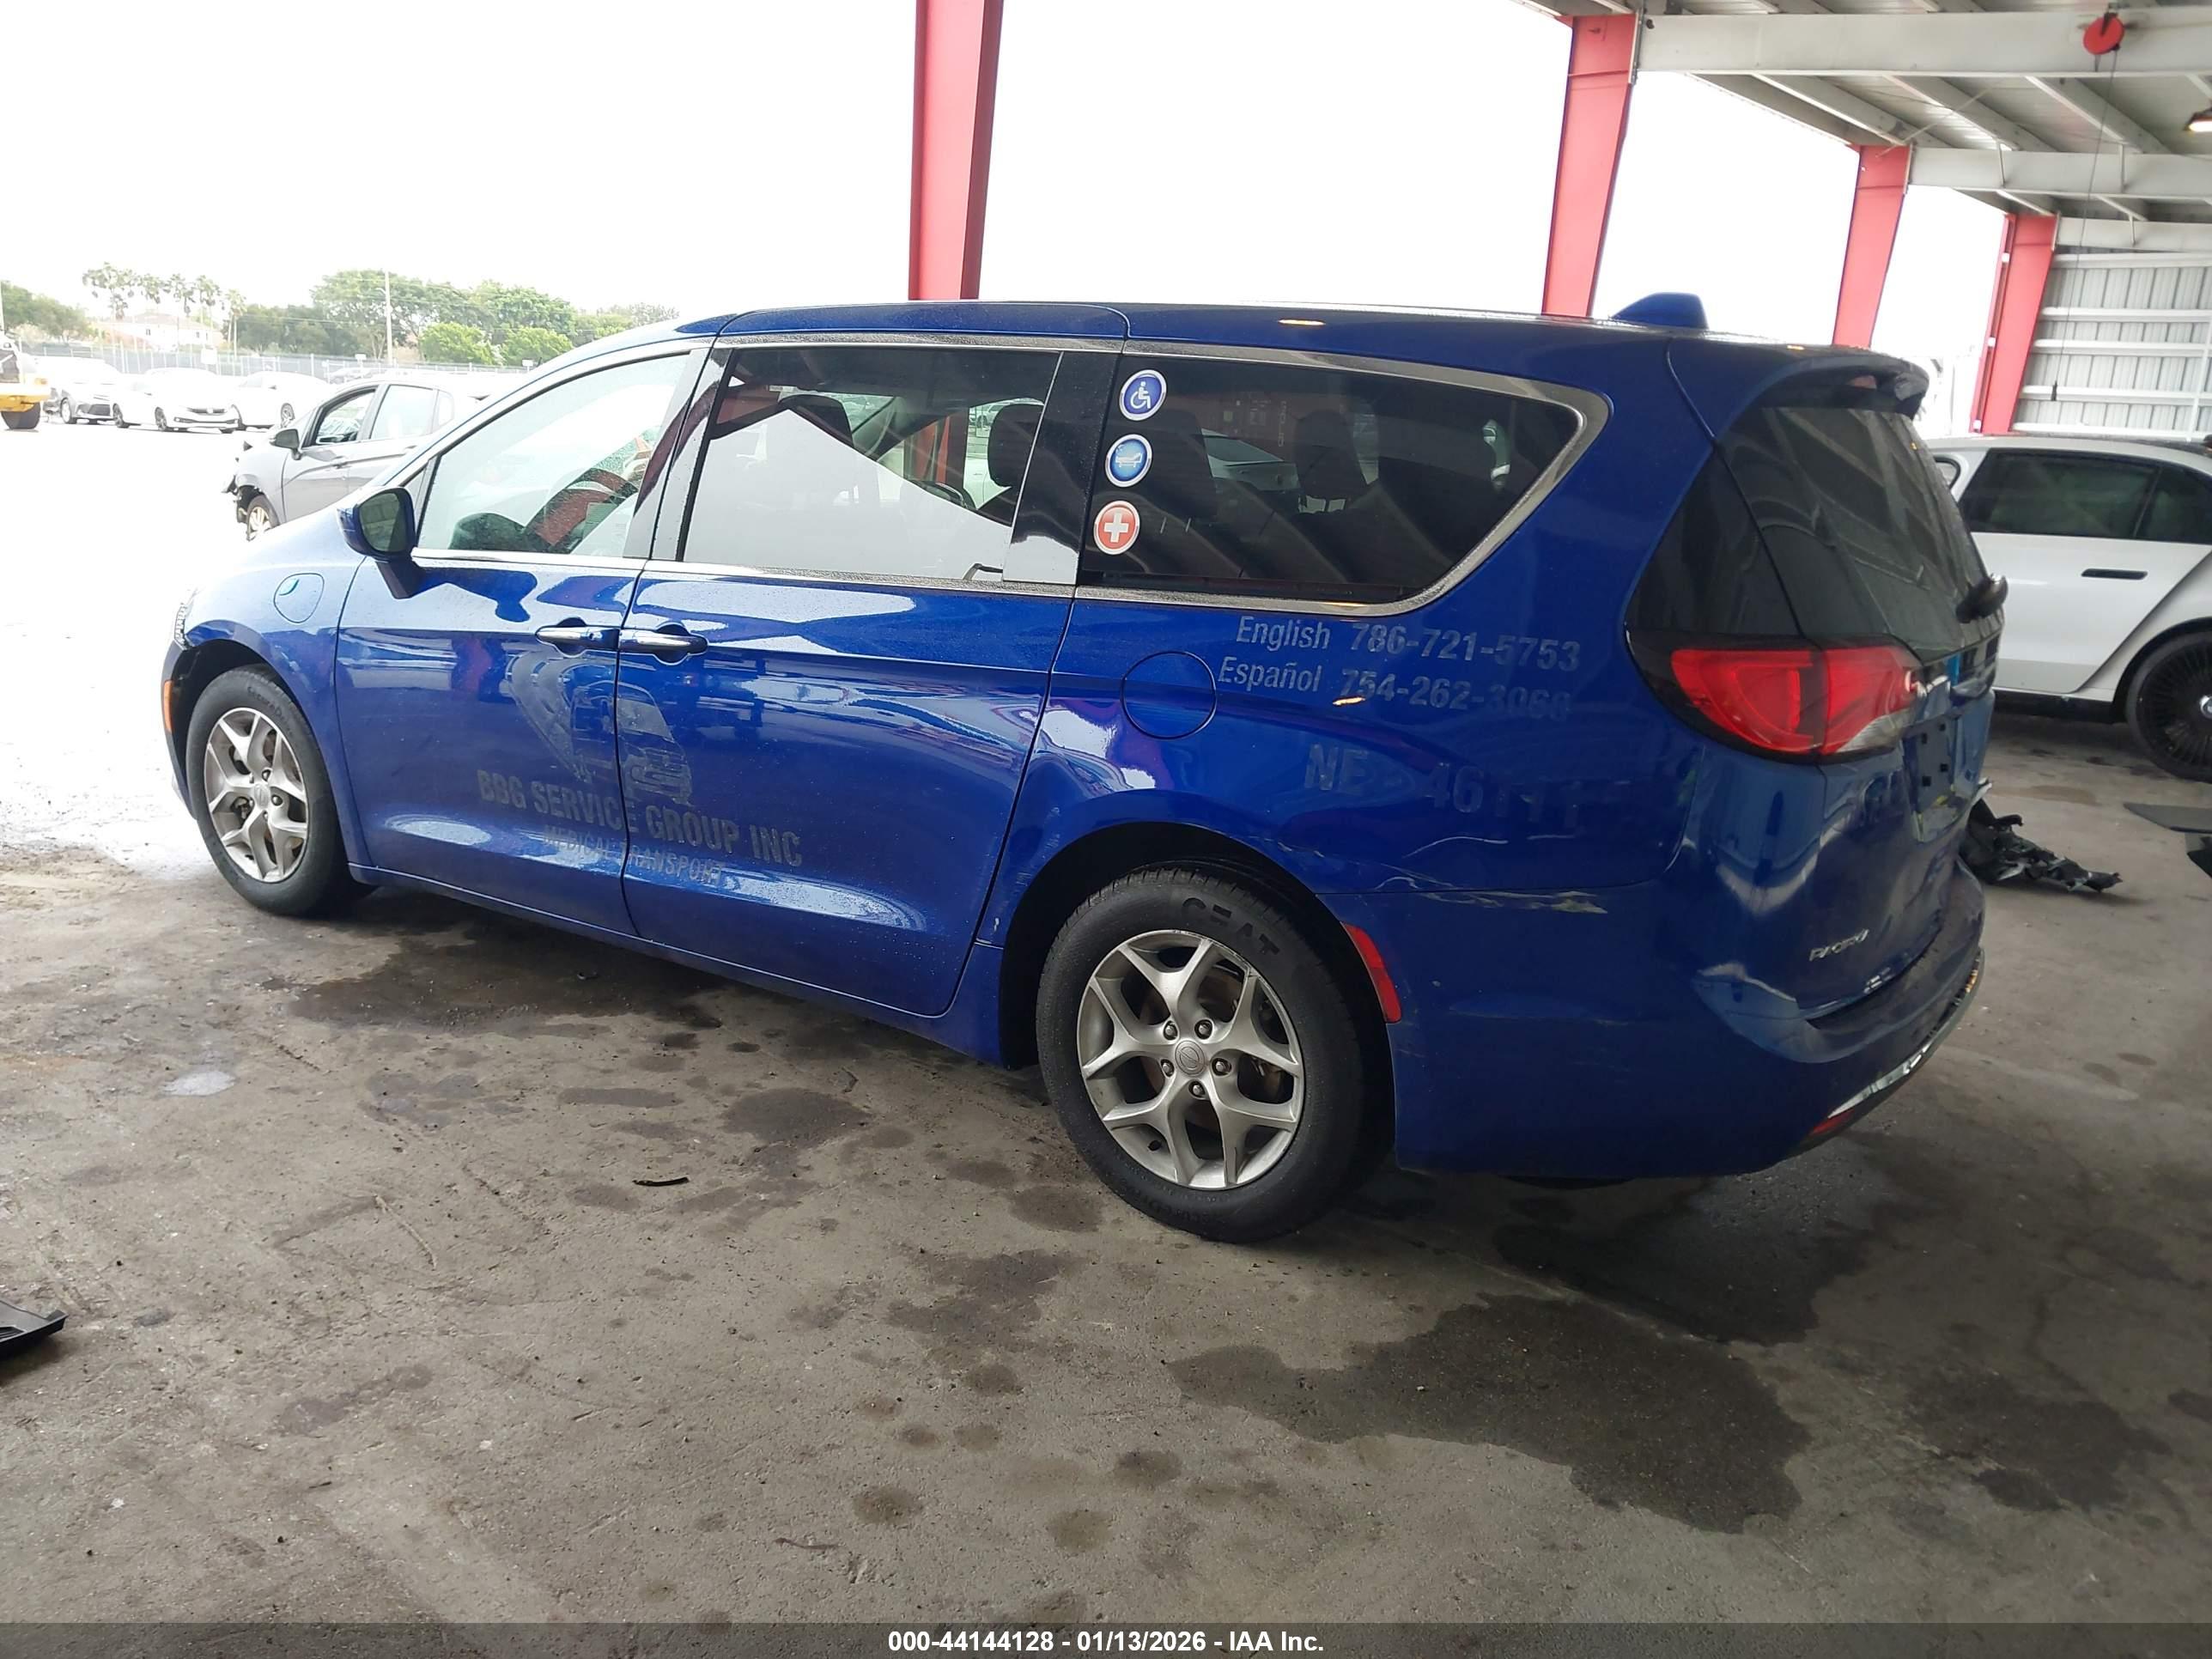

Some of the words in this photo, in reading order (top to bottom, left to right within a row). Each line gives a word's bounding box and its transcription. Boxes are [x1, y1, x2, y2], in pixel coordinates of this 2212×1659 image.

[1235, 616, 1331, 652] English
[1350, 622, 1581, 672] 786-721-5753
[1218, 655, 1322, 693] Español
[477, 769, 527, 810] BBG
[531, 780, 640, 834] SERVICE
[645, 805, 739, 854] GROUP
[748, 823, 803, 868] INC
[618, 838, 726, 886] TRANSPORT
[1180, 896, 1281, 956] CEAT
